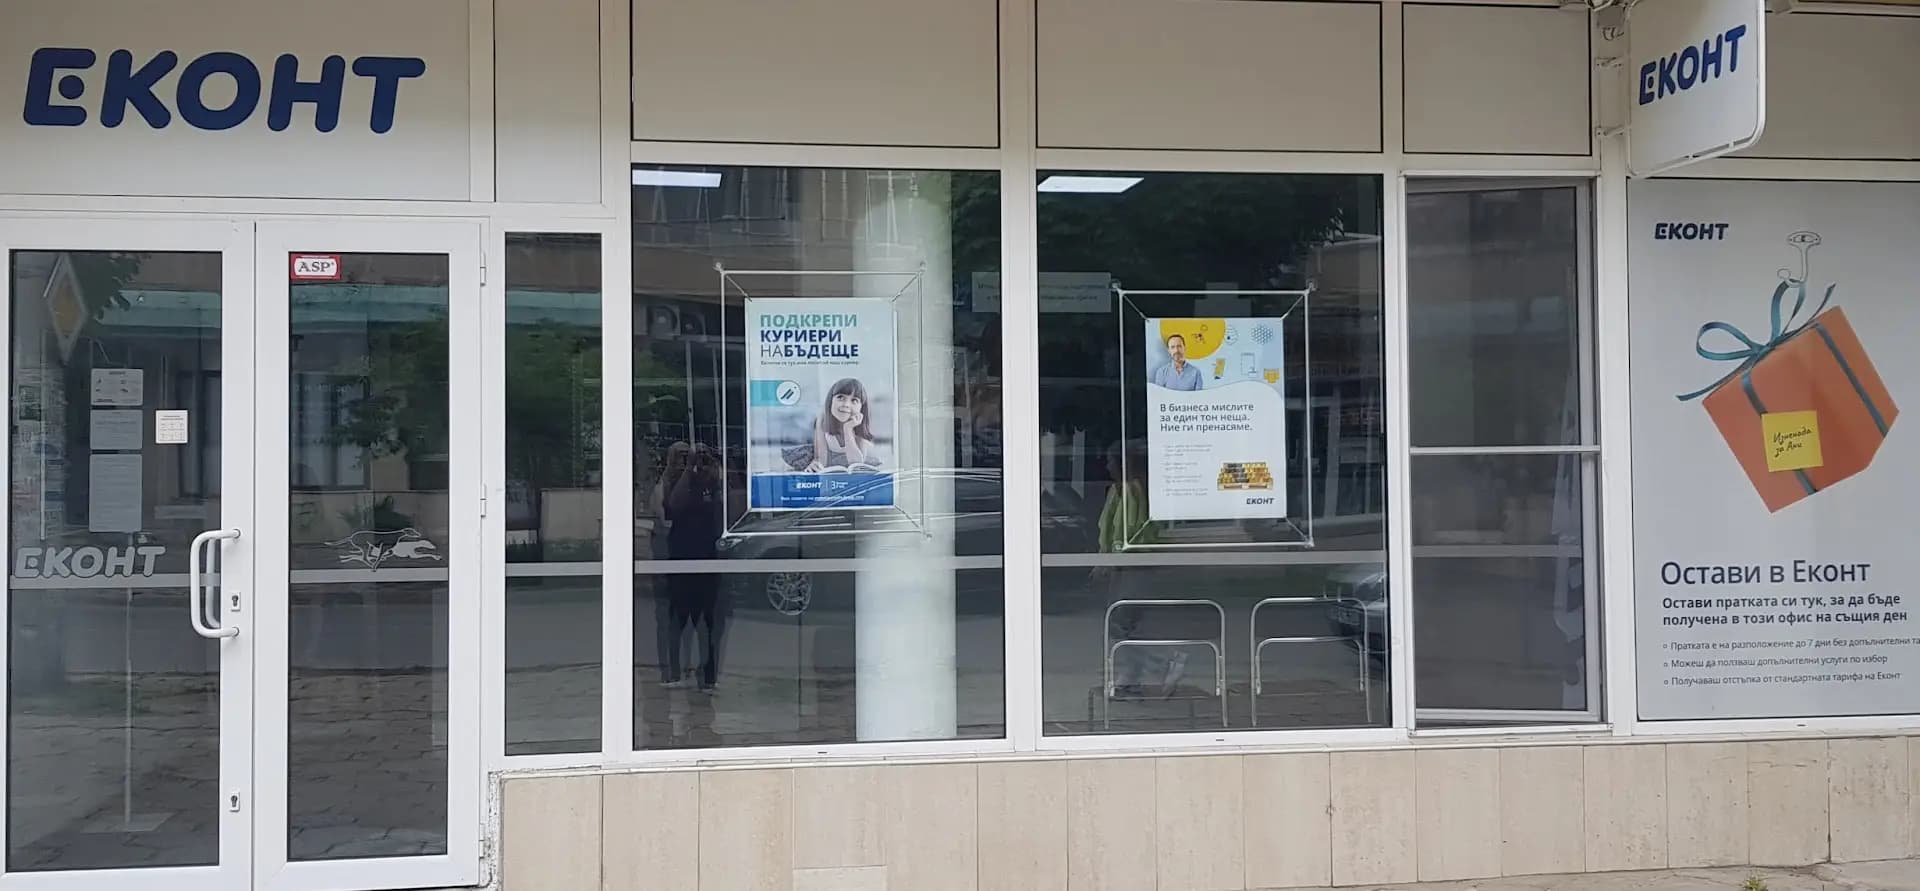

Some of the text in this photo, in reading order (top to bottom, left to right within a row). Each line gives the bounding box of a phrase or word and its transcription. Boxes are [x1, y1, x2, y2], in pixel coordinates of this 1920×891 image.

[1639, 24, 1747, 106] ЕКОНТ
[23, 47, 426, 134] ЕКОНТ
[1655, 223, 1729, 240] ЕКОНТ
[760, 314, 858, 329] ПОДКРЕПИ
[760, 329, 842, 343] КУРИЕРИ
[1160, 404, 1166, 412] В
[1169, 403, 1208, 412] бизнеса
[1173, 415, 1198, 423] един
[1221, 414, 1250, 422] неща.
[1196, 424, 1252, 433] пренасяме.
[14, 545, 166, 579] ЕКОНТ
[1661, 560, 1870, 585] Остави в Еконт
[1663, 593, 1900, 611] Остави пратката си тук, за да бъде
[1664, 612, 1907, 628] получена в този офис на същия ден
[1671, 642, 1710, 652] Пратката
[1732, 641, 1794, 650] разположение
[1808, 639, 1813, 647] 7
[1815, 640, 1831, 648] дни
[1833, 638, 1847, 646] без
[1849, 638, 1910, 647] допълнителни
[1705, 660, 1716, 668] да
[1757, 657, 1819, 666] допълнителни
[1821, 657, 1848, 666] услуги
[1863, 655, 1887, 664] избор
[1672, 677, 1720, 687] Получаваш
[1775, 675, 1831, 684] стандартната
[1833, 673, 1863, 682] тарифа
[1877, 672, 1900, 680] Еконт
